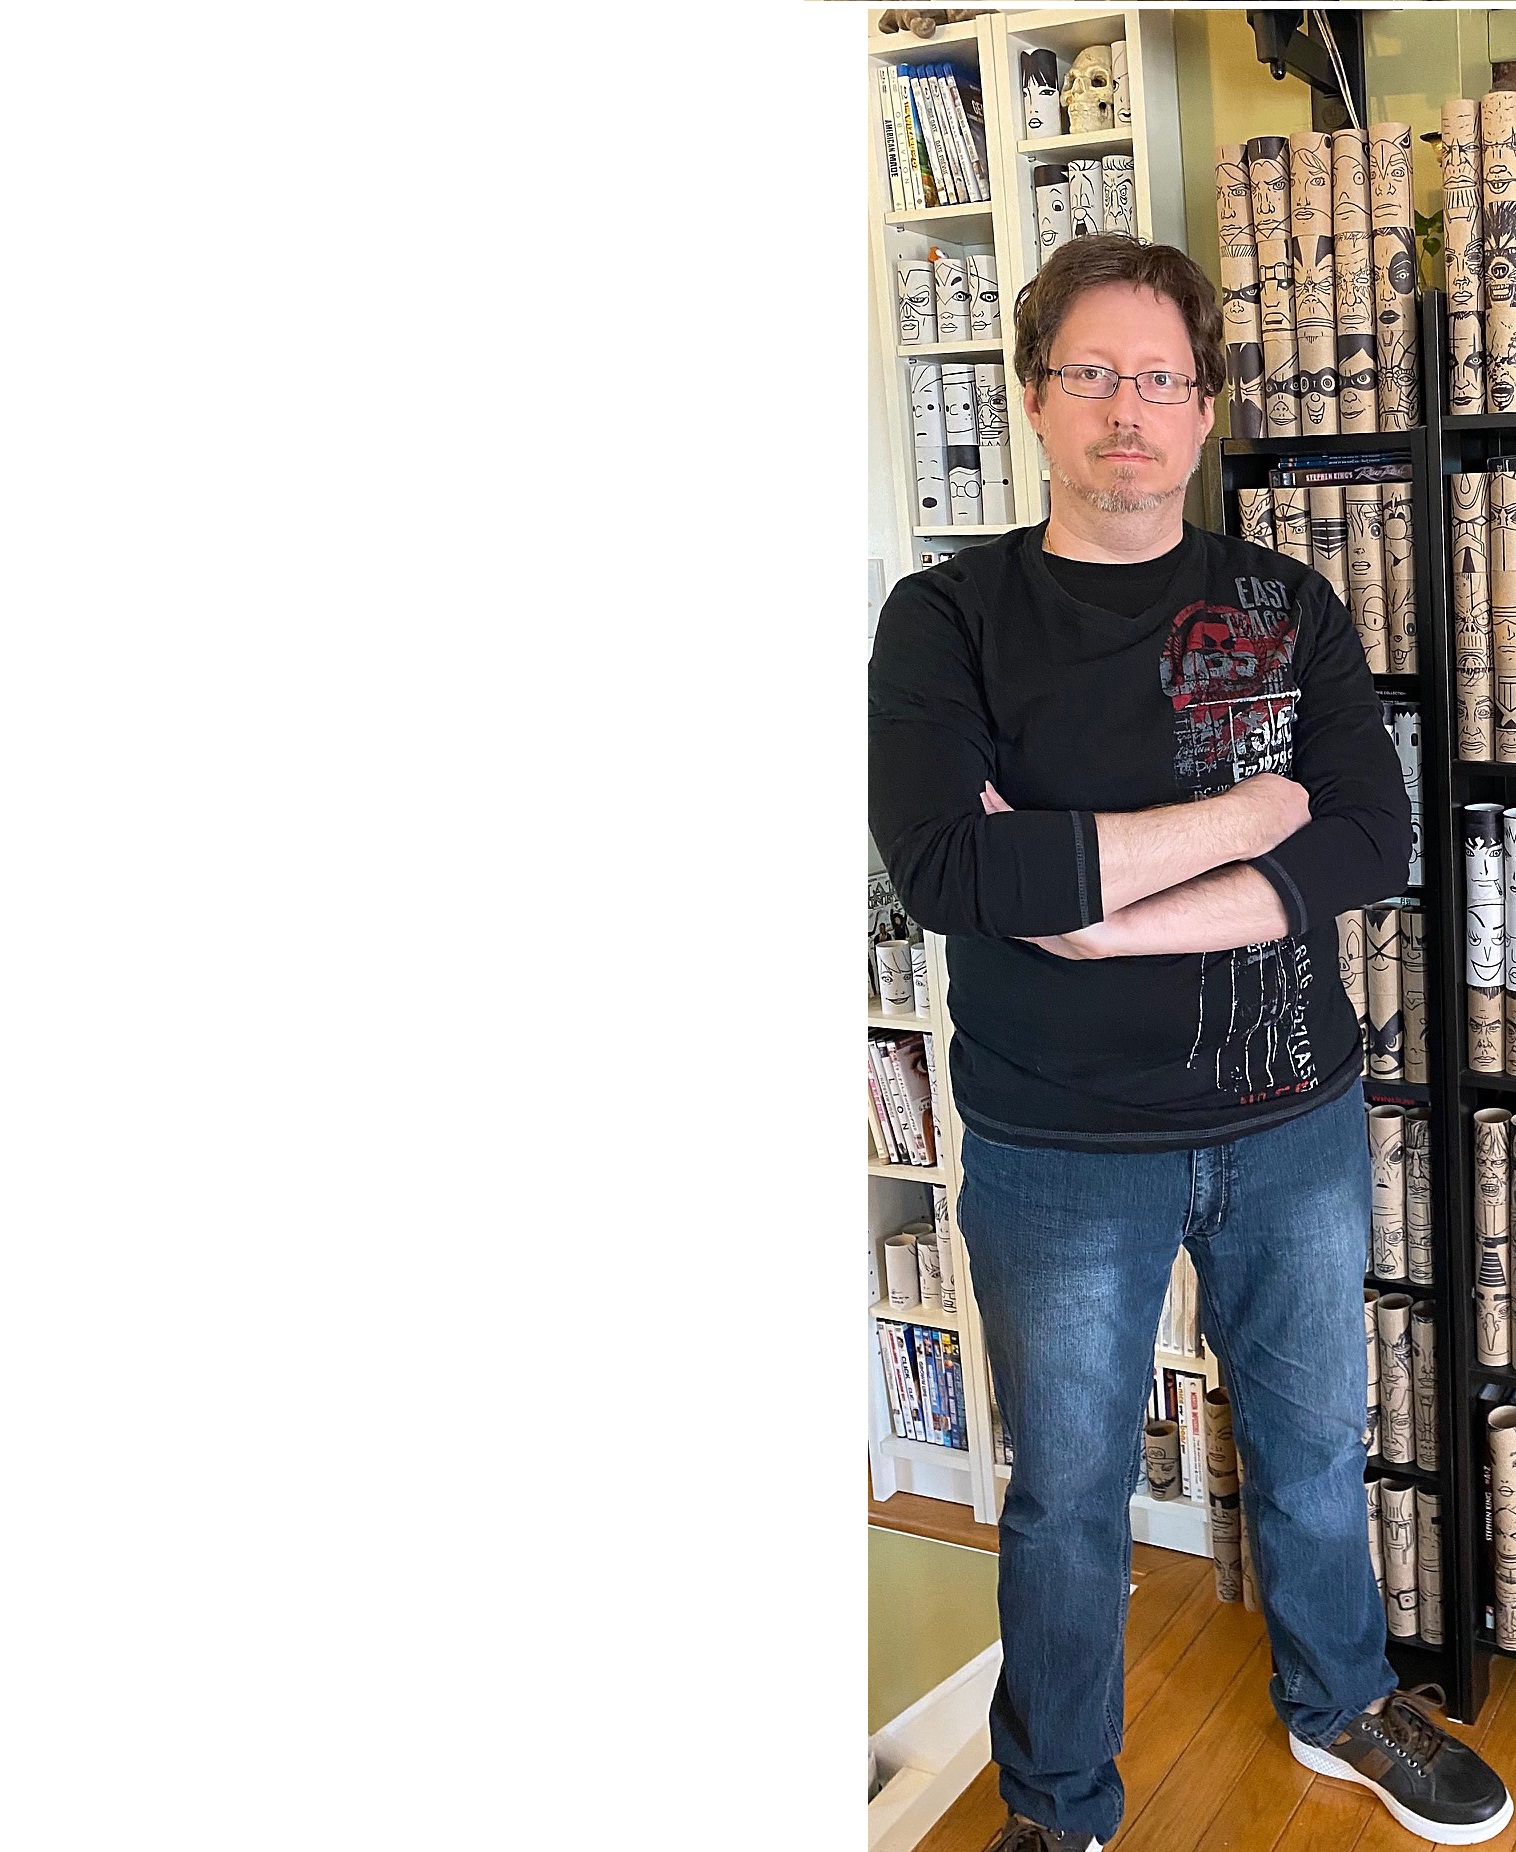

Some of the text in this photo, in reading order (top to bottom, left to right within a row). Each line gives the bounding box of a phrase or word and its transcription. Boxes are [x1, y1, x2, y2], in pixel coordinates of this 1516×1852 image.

[884, 120, 899, 177] AMERICAN MADE
[895, 111, 910, 184] OBLIVION
[1305, 472, 1333, 482] STEPHEN
[1234, 576, 1292, 611] EAST
[888, 1077, 909, 1131] LION
[901, 1356, 911, 1379] CLICK
[1484, 1491, 1492, 1510] KING
